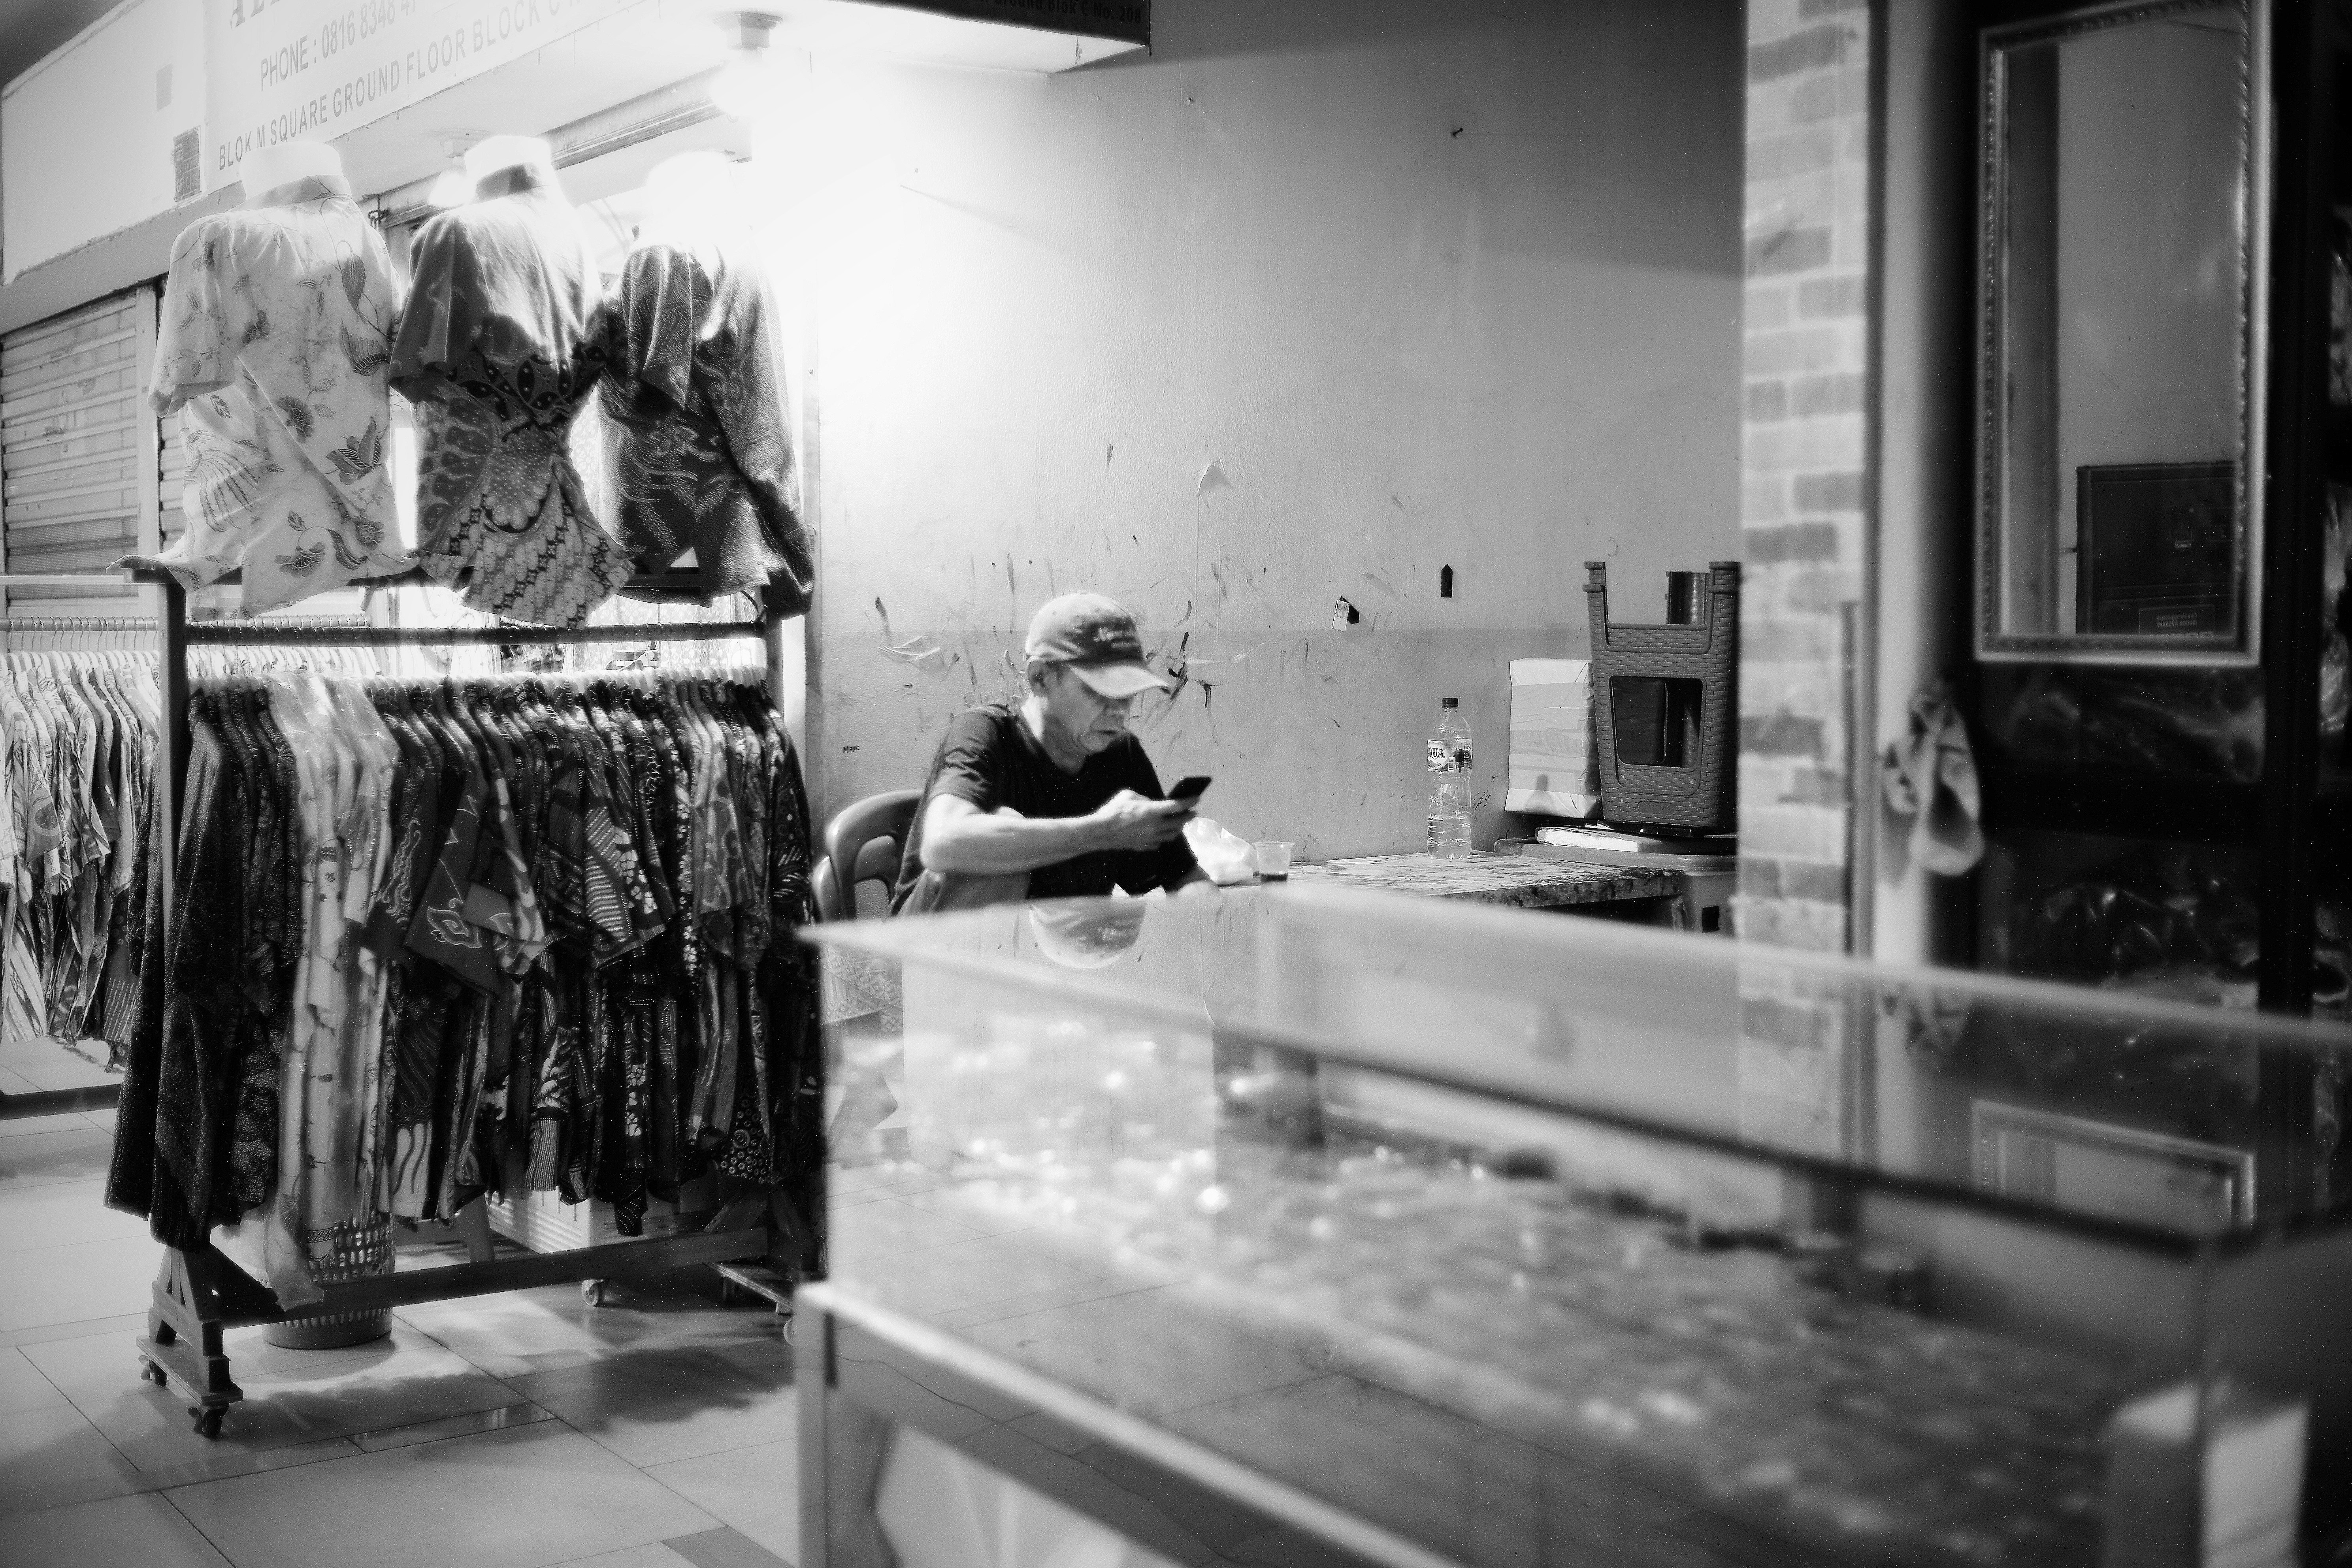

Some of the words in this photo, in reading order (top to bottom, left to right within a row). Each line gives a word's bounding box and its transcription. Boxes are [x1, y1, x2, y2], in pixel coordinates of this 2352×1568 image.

[1093, 2, 1114, 20] No.
[1119, 6, 1141, 24] 208
[261, 35, 308, 91] PHONE
[322, 10, 355, 58] 0816
[360, 0, 395, 39] 8348
[219, 131, 252, 171] BLOK
[257, 124, 266, 148] M
[270, 94, 328, 145] SQUARE
[333, 60, 400, 117] GROUND
[407, 28, 466, 84] FLOOR
[473, 0, 541, 53] BLOCK
[1428, 747, 1445, 760] QUA
